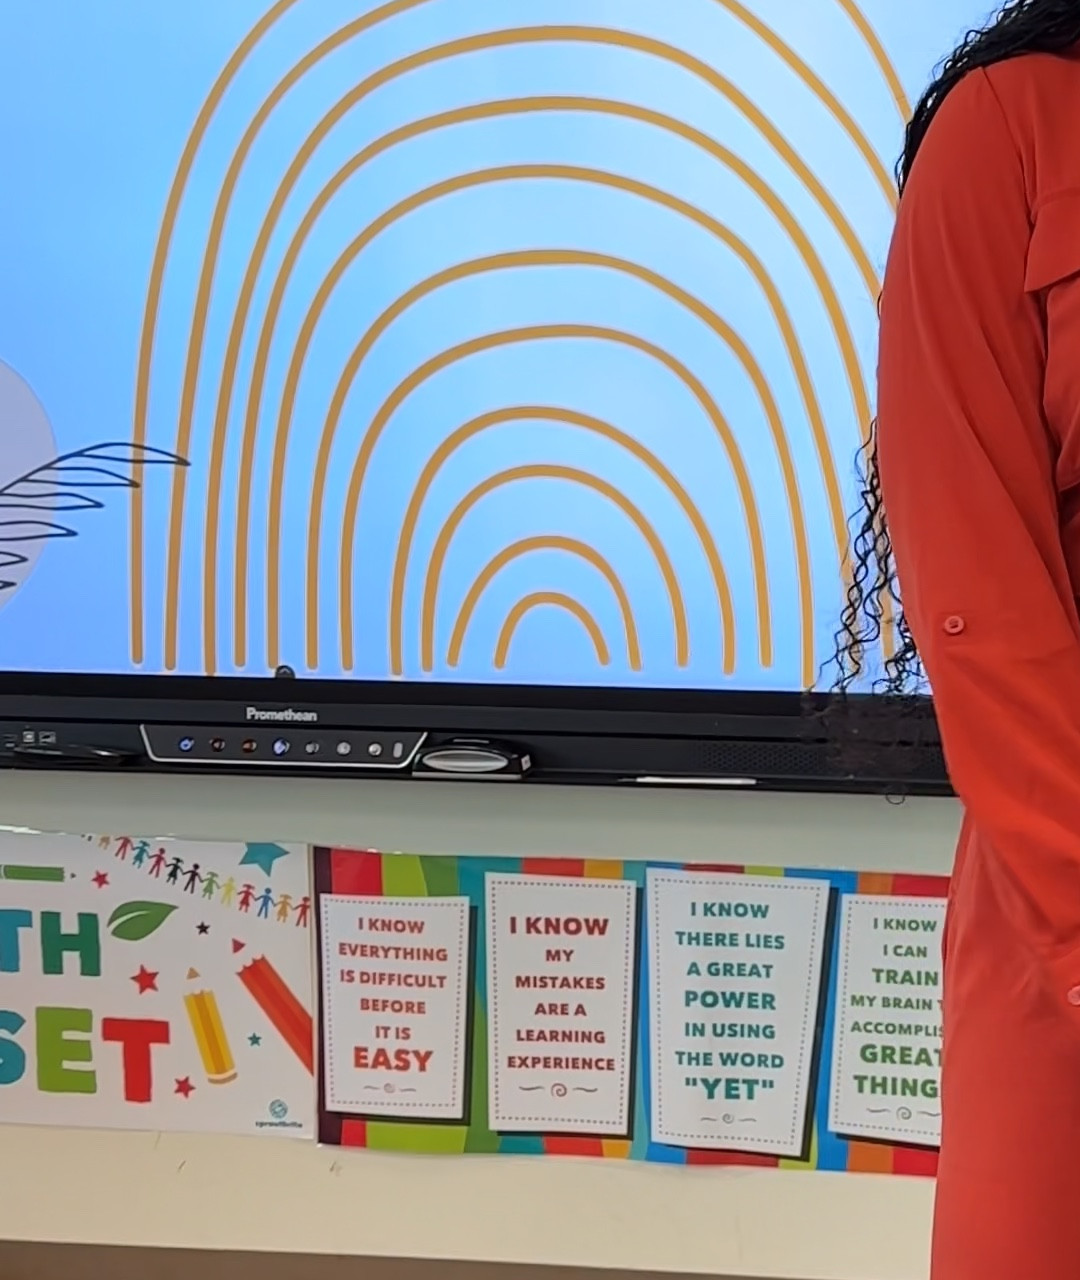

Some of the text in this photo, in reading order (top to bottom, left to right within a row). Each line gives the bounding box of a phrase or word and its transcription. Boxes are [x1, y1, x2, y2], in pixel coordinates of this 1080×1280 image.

[246, 707, 317, 722] Promethean
[691, 902, 769, 918] I KNOW
[358, 918, 424, 934] I KNOW
[510, 917, 609, 936] I KNOW
[874, 918, 937, 932] I KNOW
[675, 932, 785, 950] THERE LIES
[339, 942, 448, 962] EVERYTHING
[546, 950, 574, 962] MY
[883, 945, 927, 958] I CAN
[687, 962, 773, 978] A GREAT
[872, 969, 938, 985] TRAIN
[340, 970, 447, 988] IS DIFFICULT
[515, 976, 605, 989] MISTAKES
[360, 998, 426, 1014] BEFORE
[684, 991, 776, 1010] POWER
[850, 995, 876, 1007] MY
[882, 997, 932, 1010] BRAIN
[535, 1004, 586, 1016] ARE A
[376, 1026, 410, 1039] IT IS
[516, 1030, 605, 1043] LEARNING
[684, 1023, 775, 1039] IN USING
[354, 1047, 433, 1072] EASY
[507, 1056, 615, 1070] EXPERIENCE
[675, 1051, 784, 1068] THE WORD
[685, 1078, 774, 1100] "YET"
